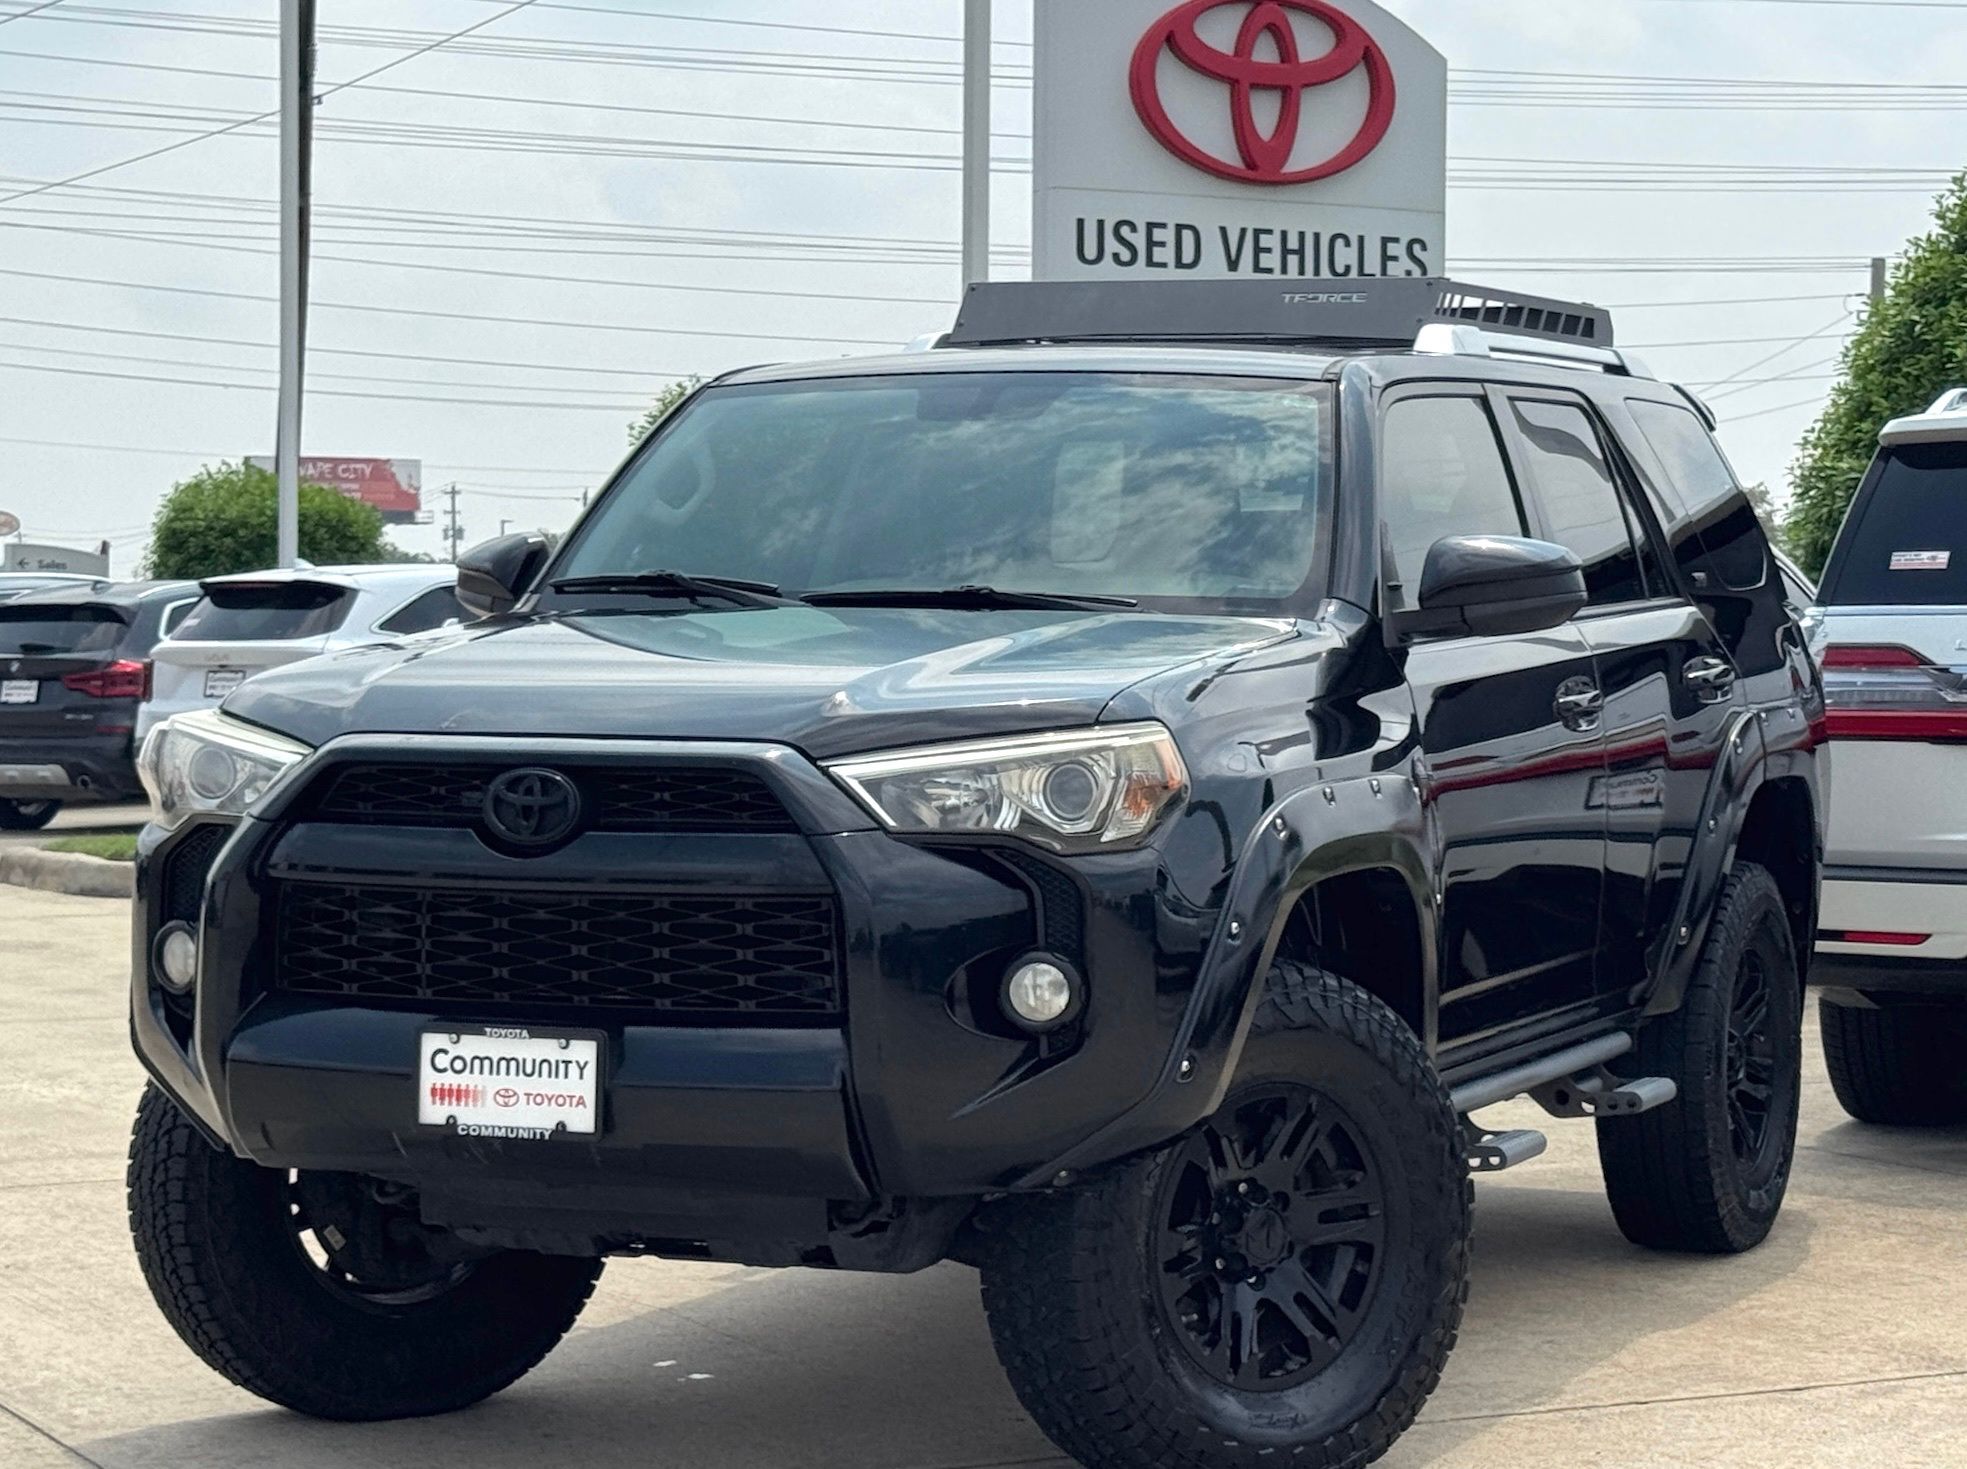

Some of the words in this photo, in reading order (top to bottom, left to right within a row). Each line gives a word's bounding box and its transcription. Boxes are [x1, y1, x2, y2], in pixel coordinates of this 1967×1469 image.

[1075, 217, 1202, 270] USED
[1218, 225, 1429, 278] VEHICLES
[1280, 293, 1369, 304] TFORCE
[484, 1027, 530, 1039] TOYOTA
[523, 1092, 588, 1109] TOYOTA
[457, 1124, 553, 1140] COMMUNITY
